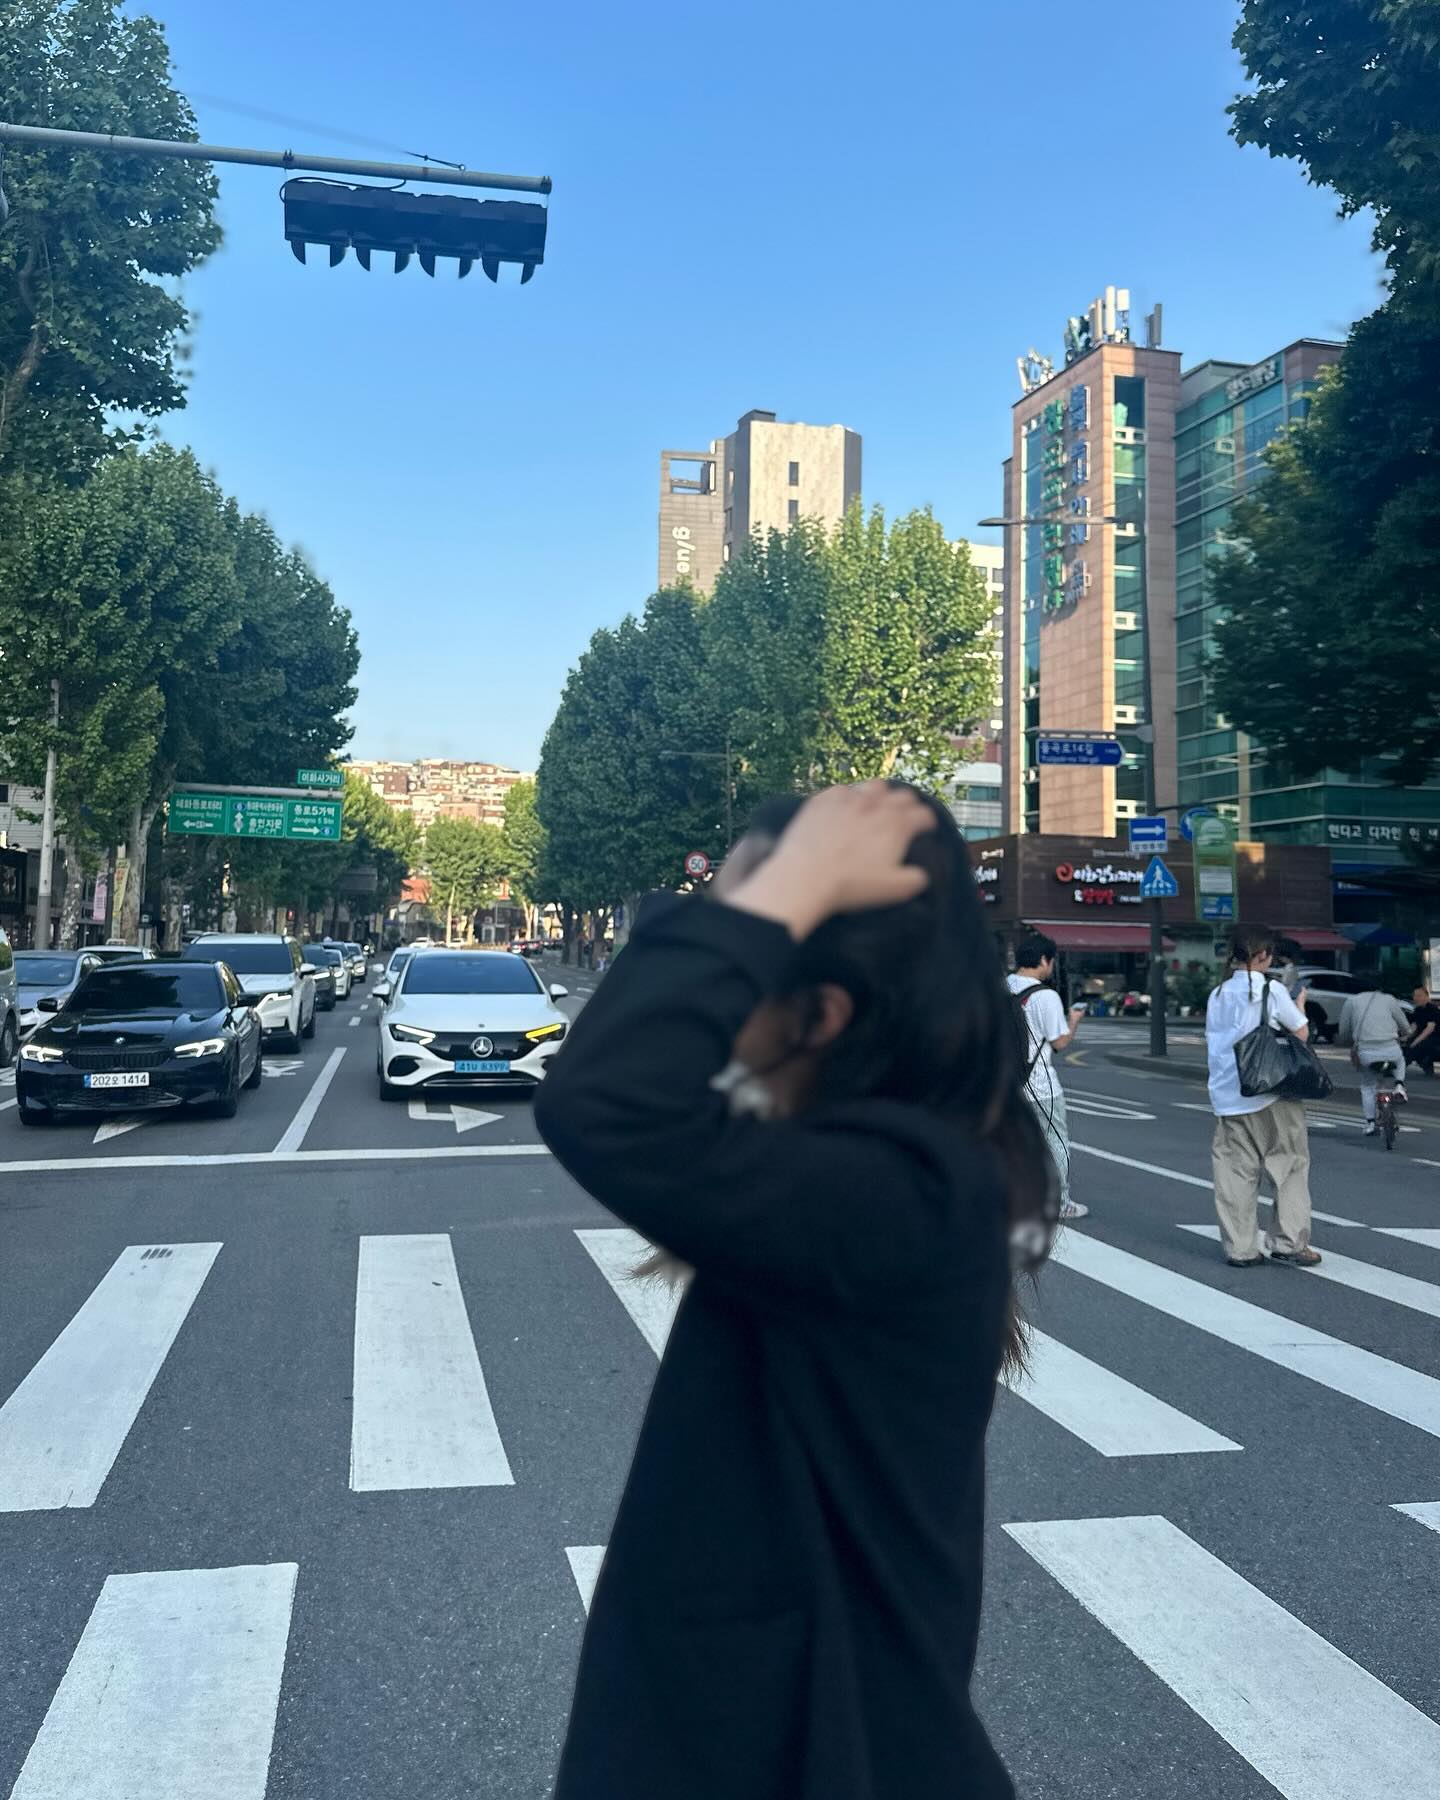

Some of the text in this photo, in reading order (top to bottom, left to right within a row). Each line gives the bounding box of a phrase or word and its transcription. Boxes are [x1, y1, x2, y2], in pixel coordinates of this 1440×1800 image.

[301, 772, 341, 784] 이화사거리
[294, 804, 335, 816] 종로5가역
[121, 1074, 146, 1085] 1414
